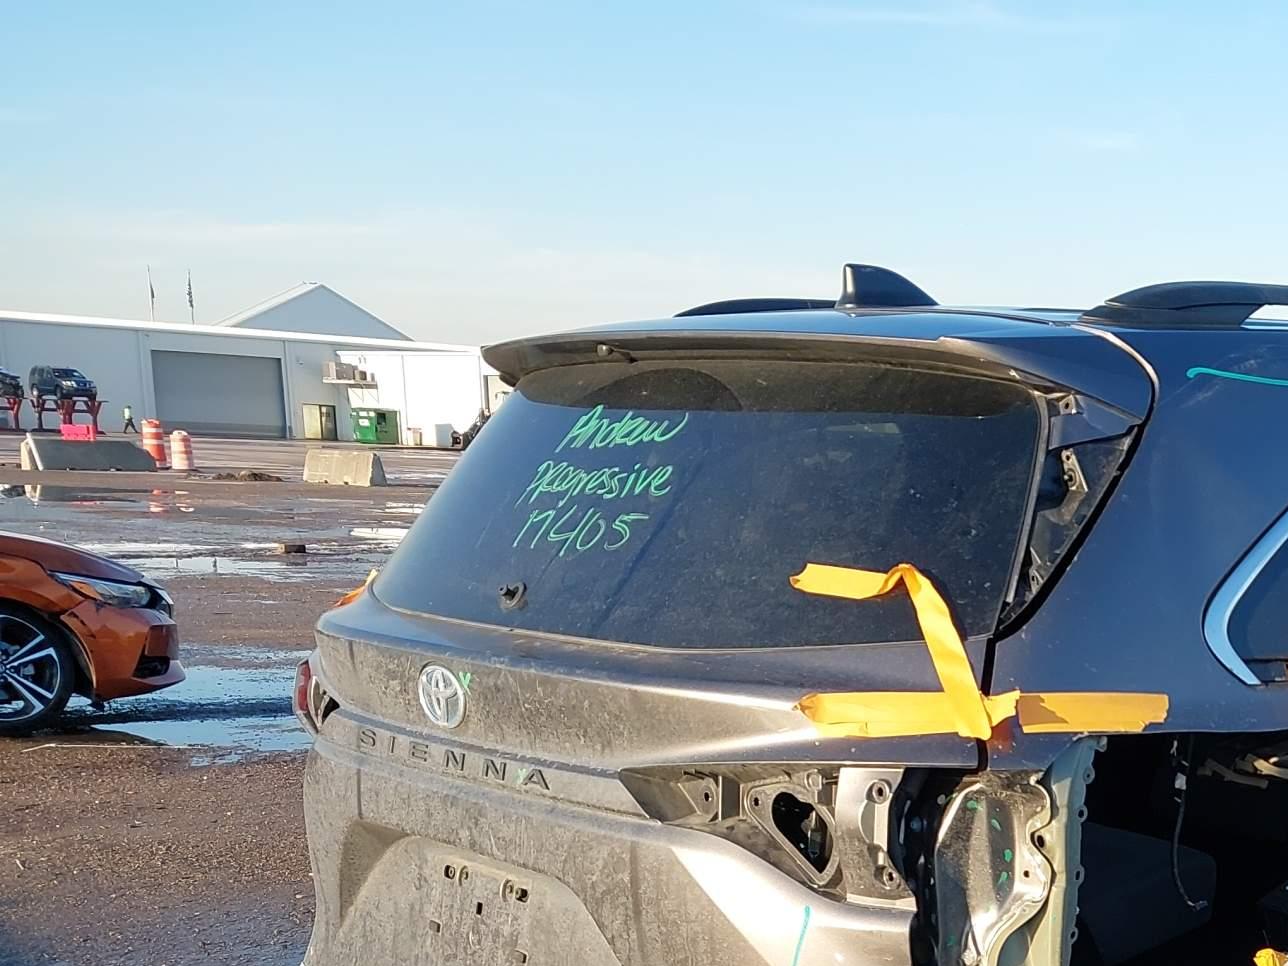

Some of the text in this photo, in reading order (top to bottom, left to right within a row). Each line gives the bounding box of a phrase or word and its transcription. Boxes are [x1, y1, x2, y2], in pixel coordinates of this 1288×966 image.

[555, 404, 690, 453] Andrew
[512, 505, 649, 557] 17405
[359, 728, 551, 791] SIENNA
